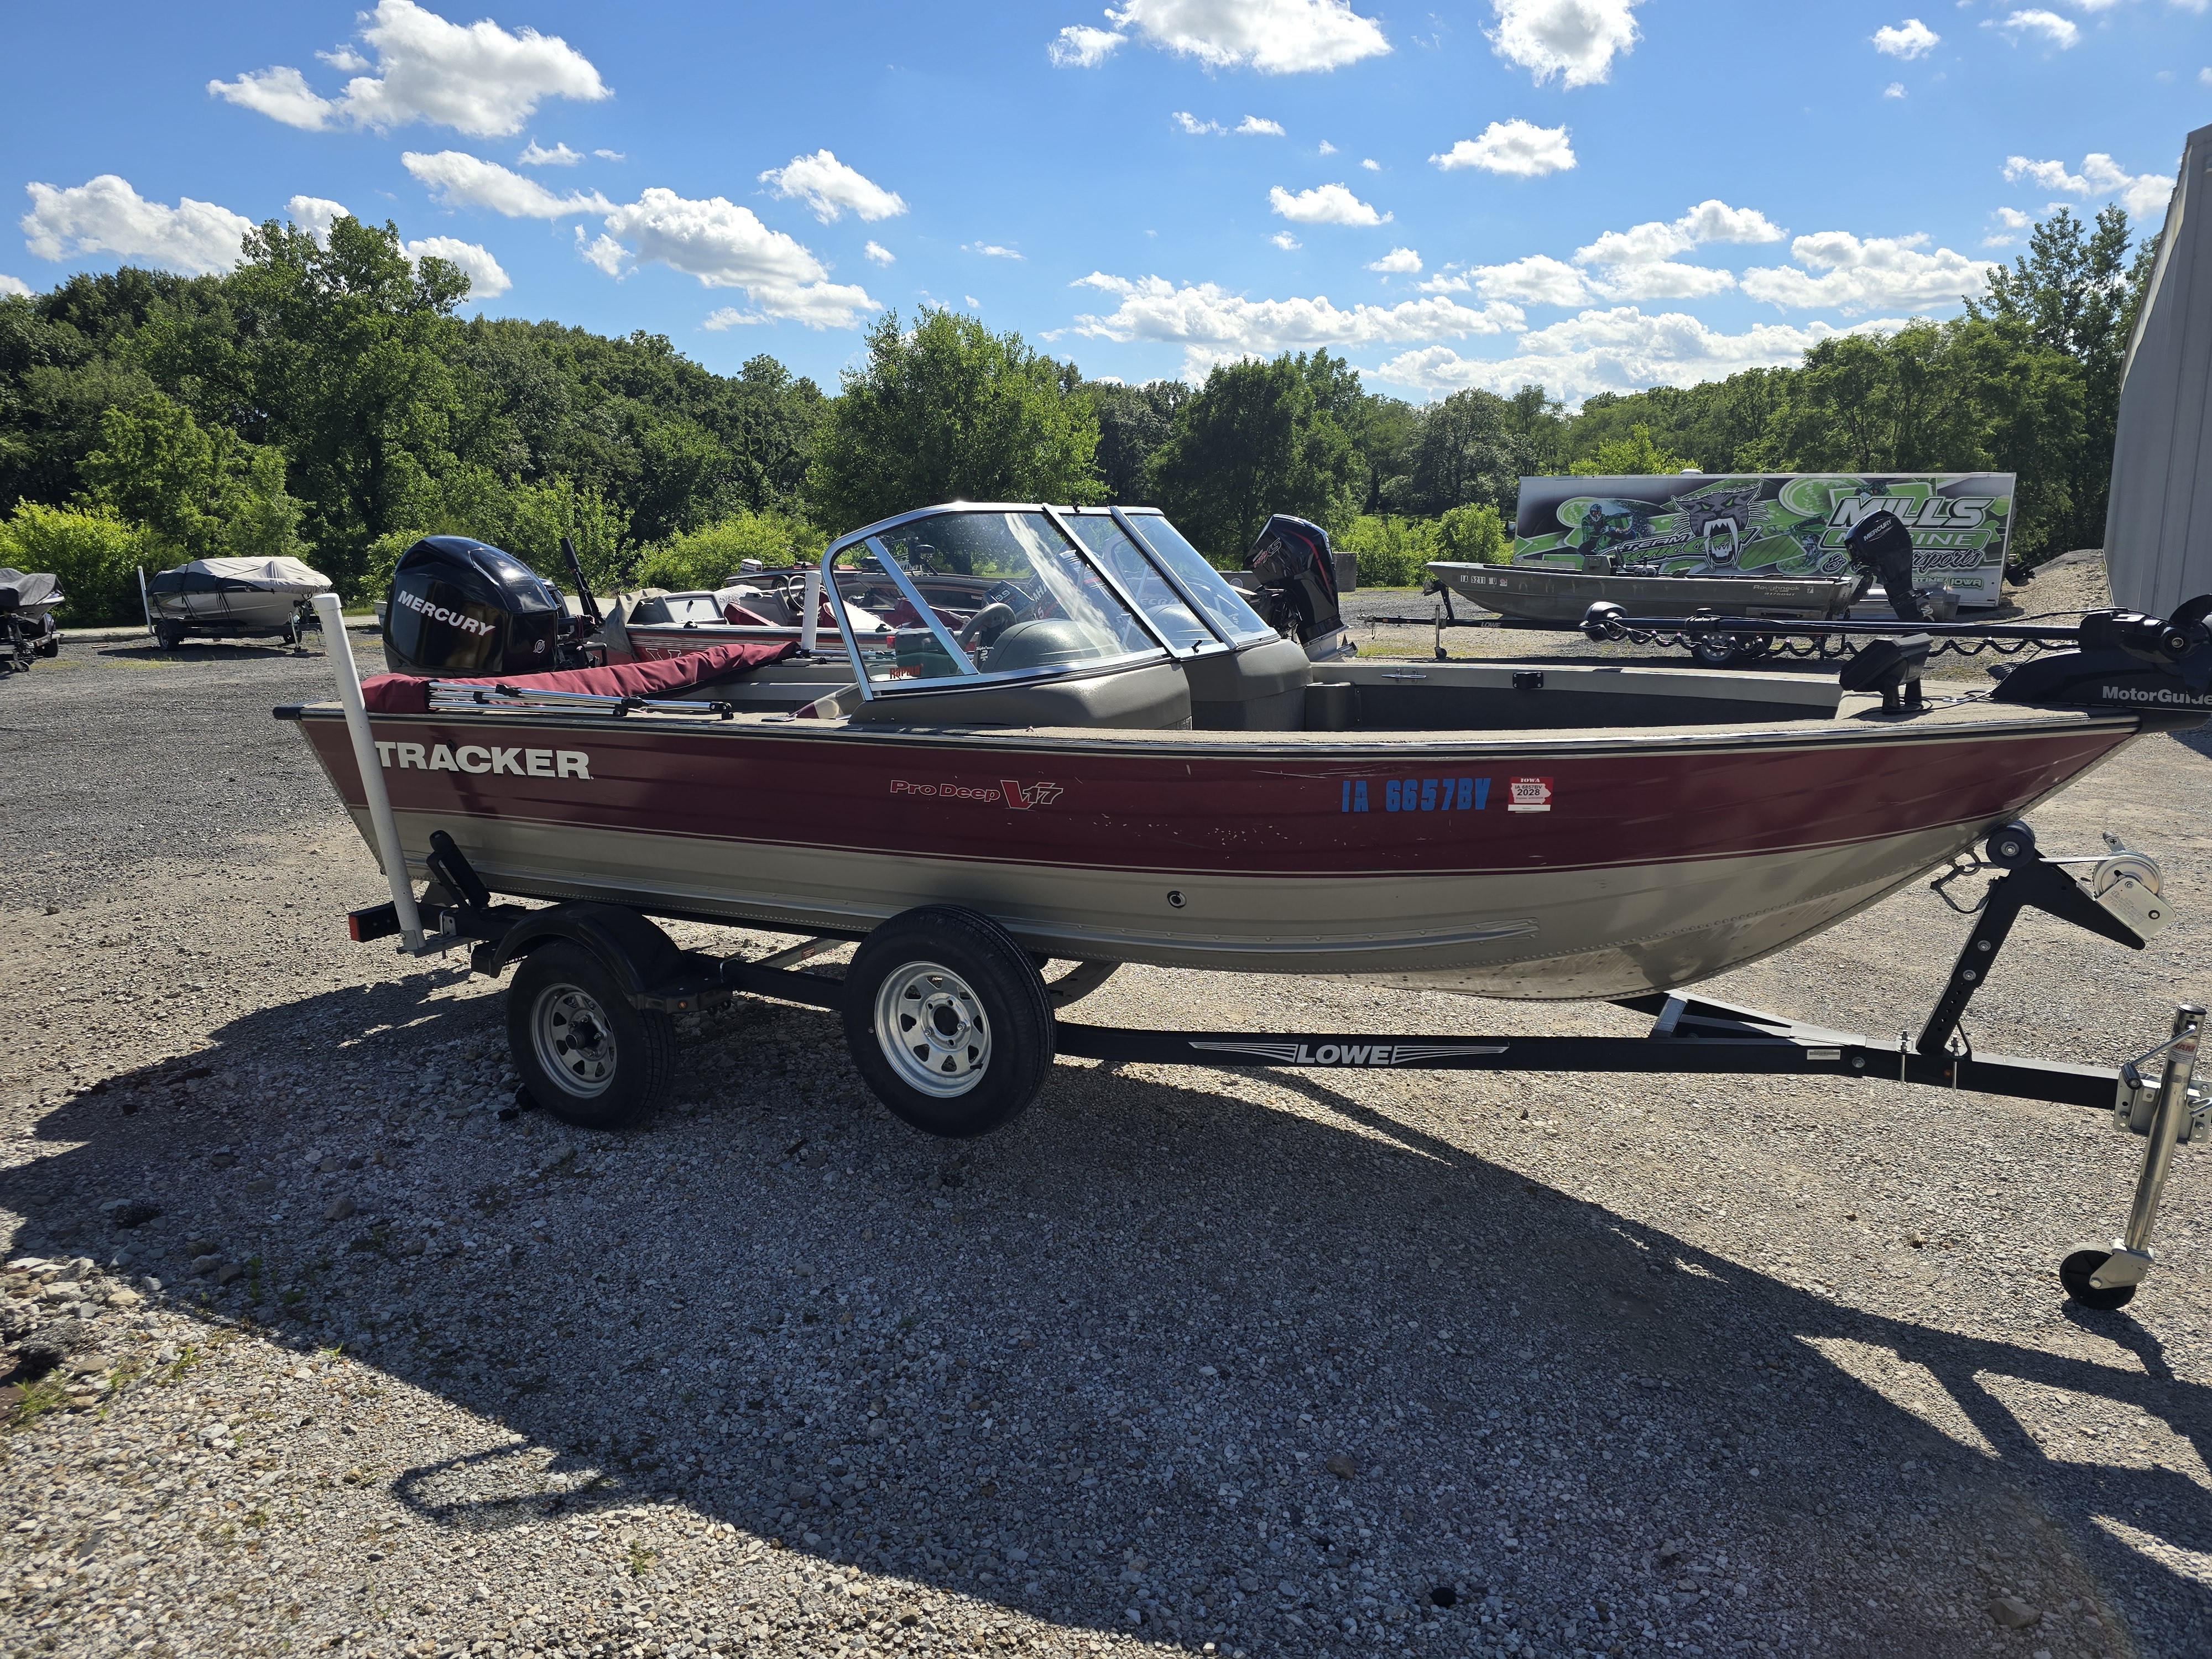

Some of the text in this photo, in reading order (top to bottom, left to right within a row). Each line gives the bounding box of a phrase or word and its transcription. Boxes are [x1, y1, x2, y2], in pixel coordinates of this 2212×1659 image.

[1827, 497, 1995, 528] MILLS
[1624, 534, 1690, 551] TEAM
[1864, 519, 1891, 541] MERCURY
[398, 590, 496, 637] MERCURY
[374, 741, 591, 780] TRACKER
[890, 779, 937, 796] Pro
[940, 783, 1000, 802] Deep
[1342, 778, 1492, 812] IA 6657BV
[1296, 1045, 1392, 1065] LOWE
